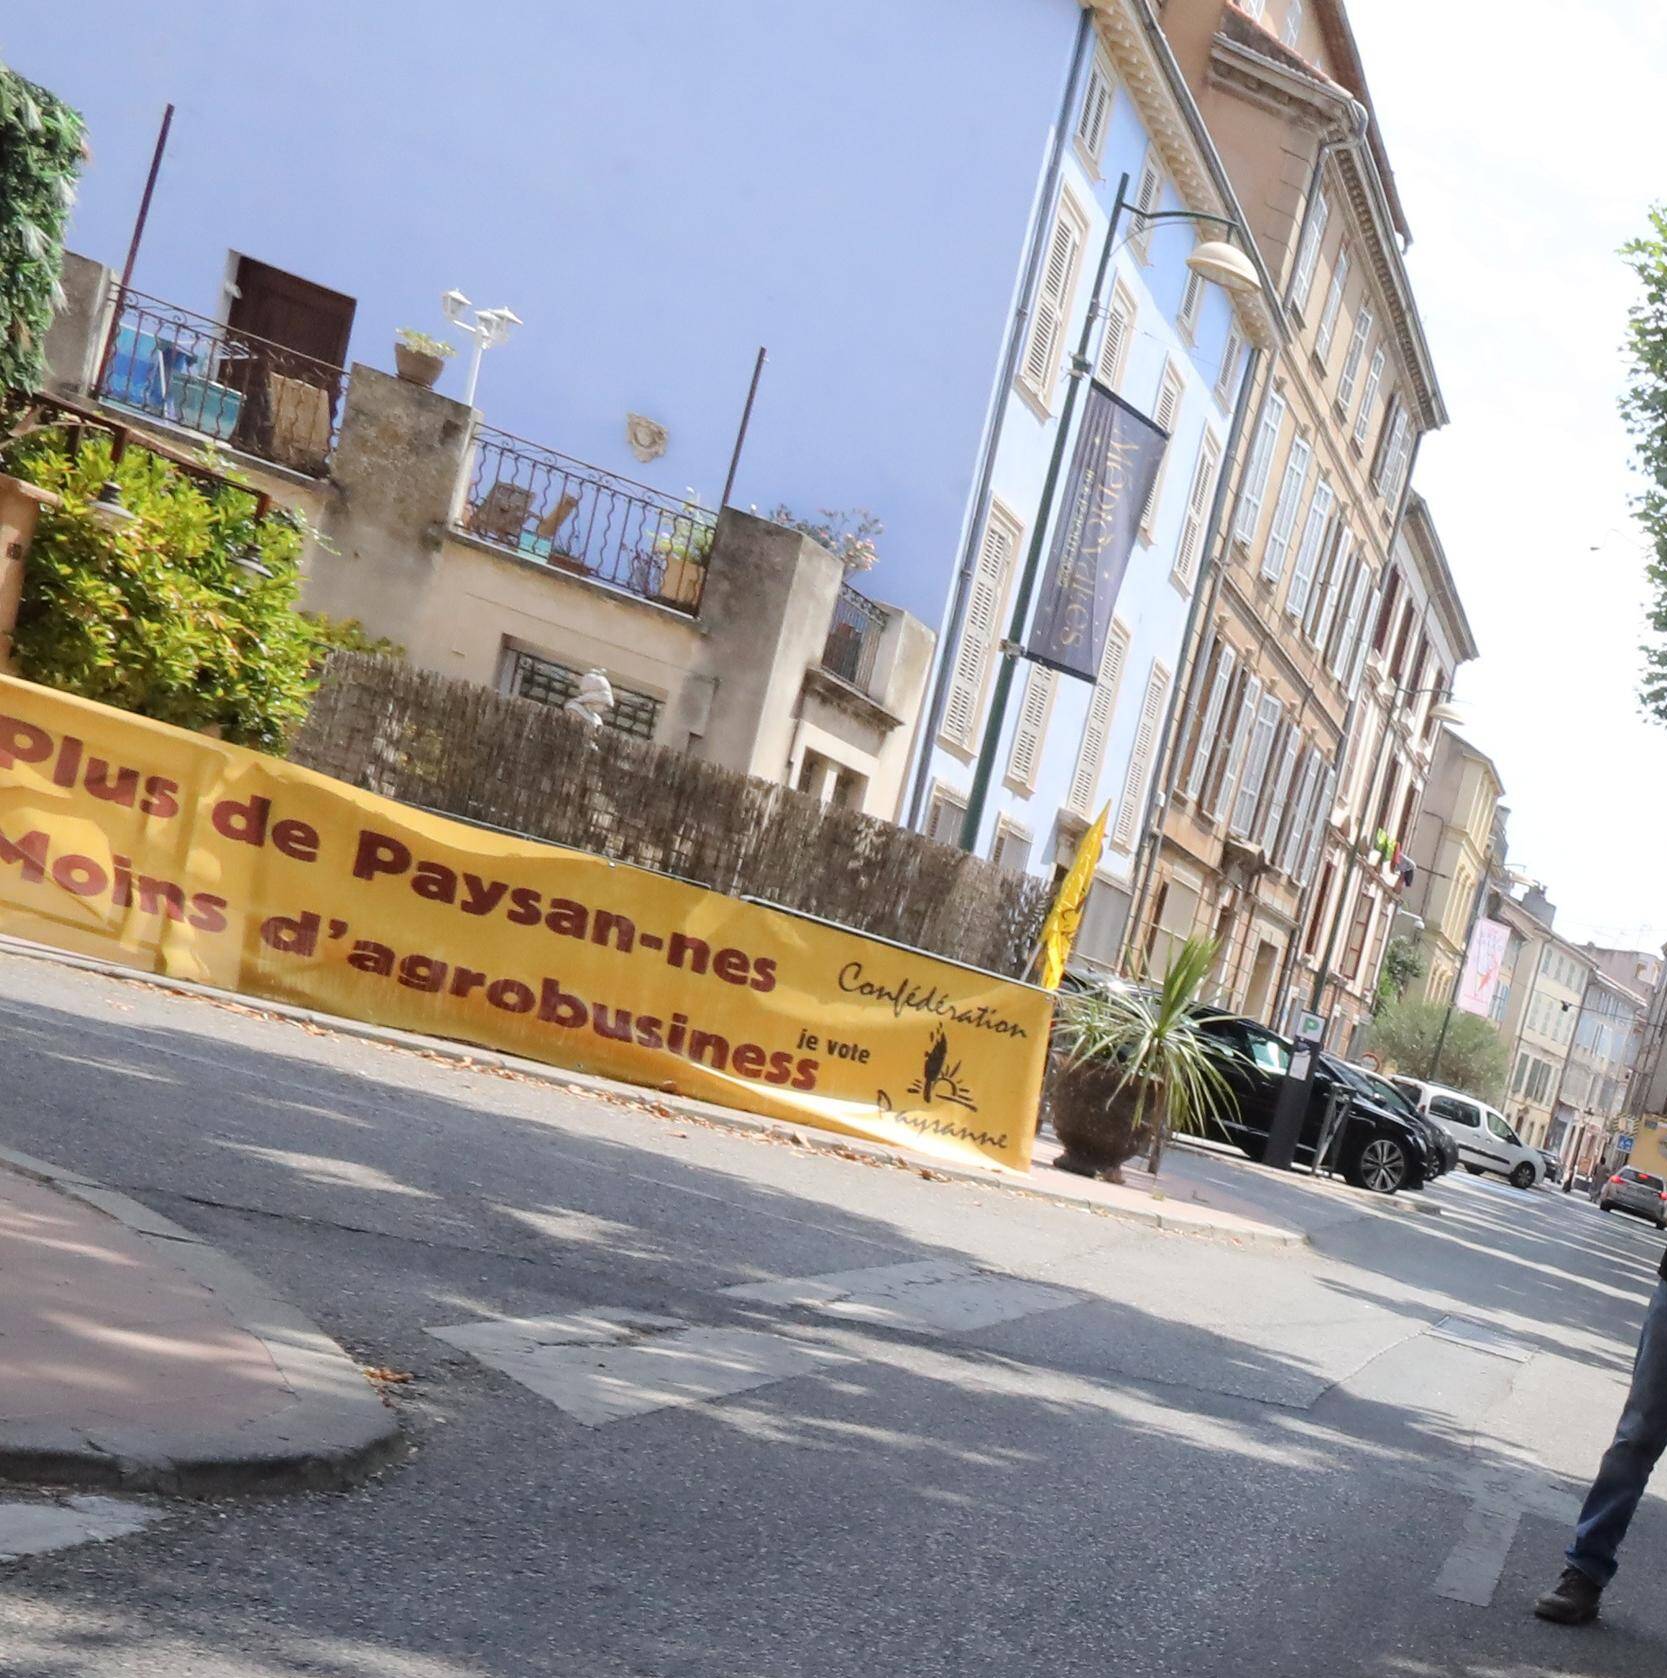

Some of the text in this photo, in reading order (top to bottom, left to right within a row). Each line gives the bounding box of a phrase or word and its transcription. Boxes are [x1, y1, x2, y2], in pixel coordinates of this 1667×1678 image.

[0, 714, 777, 992] Plus de Paysan-nes
[260, 911, 819, 1090] d'agrobusiness
[796, 1028, 871, 1064] je vote
[838, 961, 1028, 1039] Confédération
